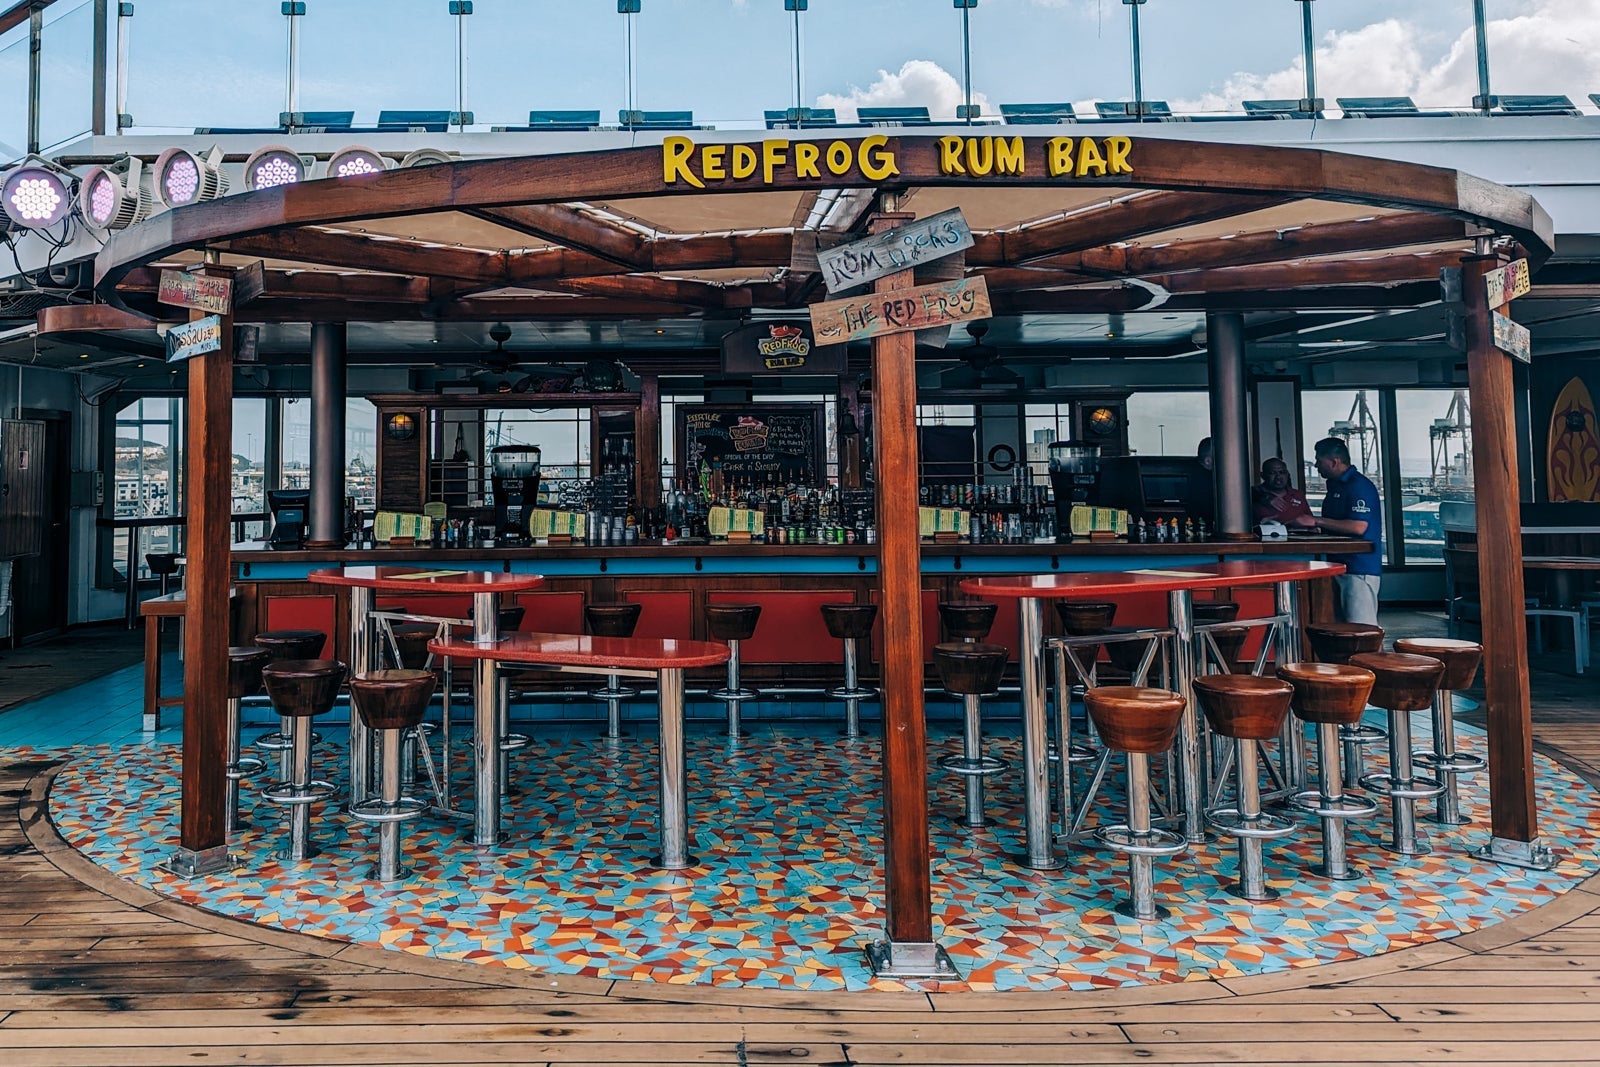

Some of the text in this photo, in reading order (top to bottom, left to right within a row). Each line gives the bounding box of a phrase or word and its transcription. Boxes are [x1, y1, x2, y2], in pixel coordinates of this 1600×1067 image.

[663, 135, 1134, 188] REDFROG RUM BAR
[840, 302, 877, 333] THE
[883, 299, 917, 327] RED
[922, 290, 975, 322] FROG
